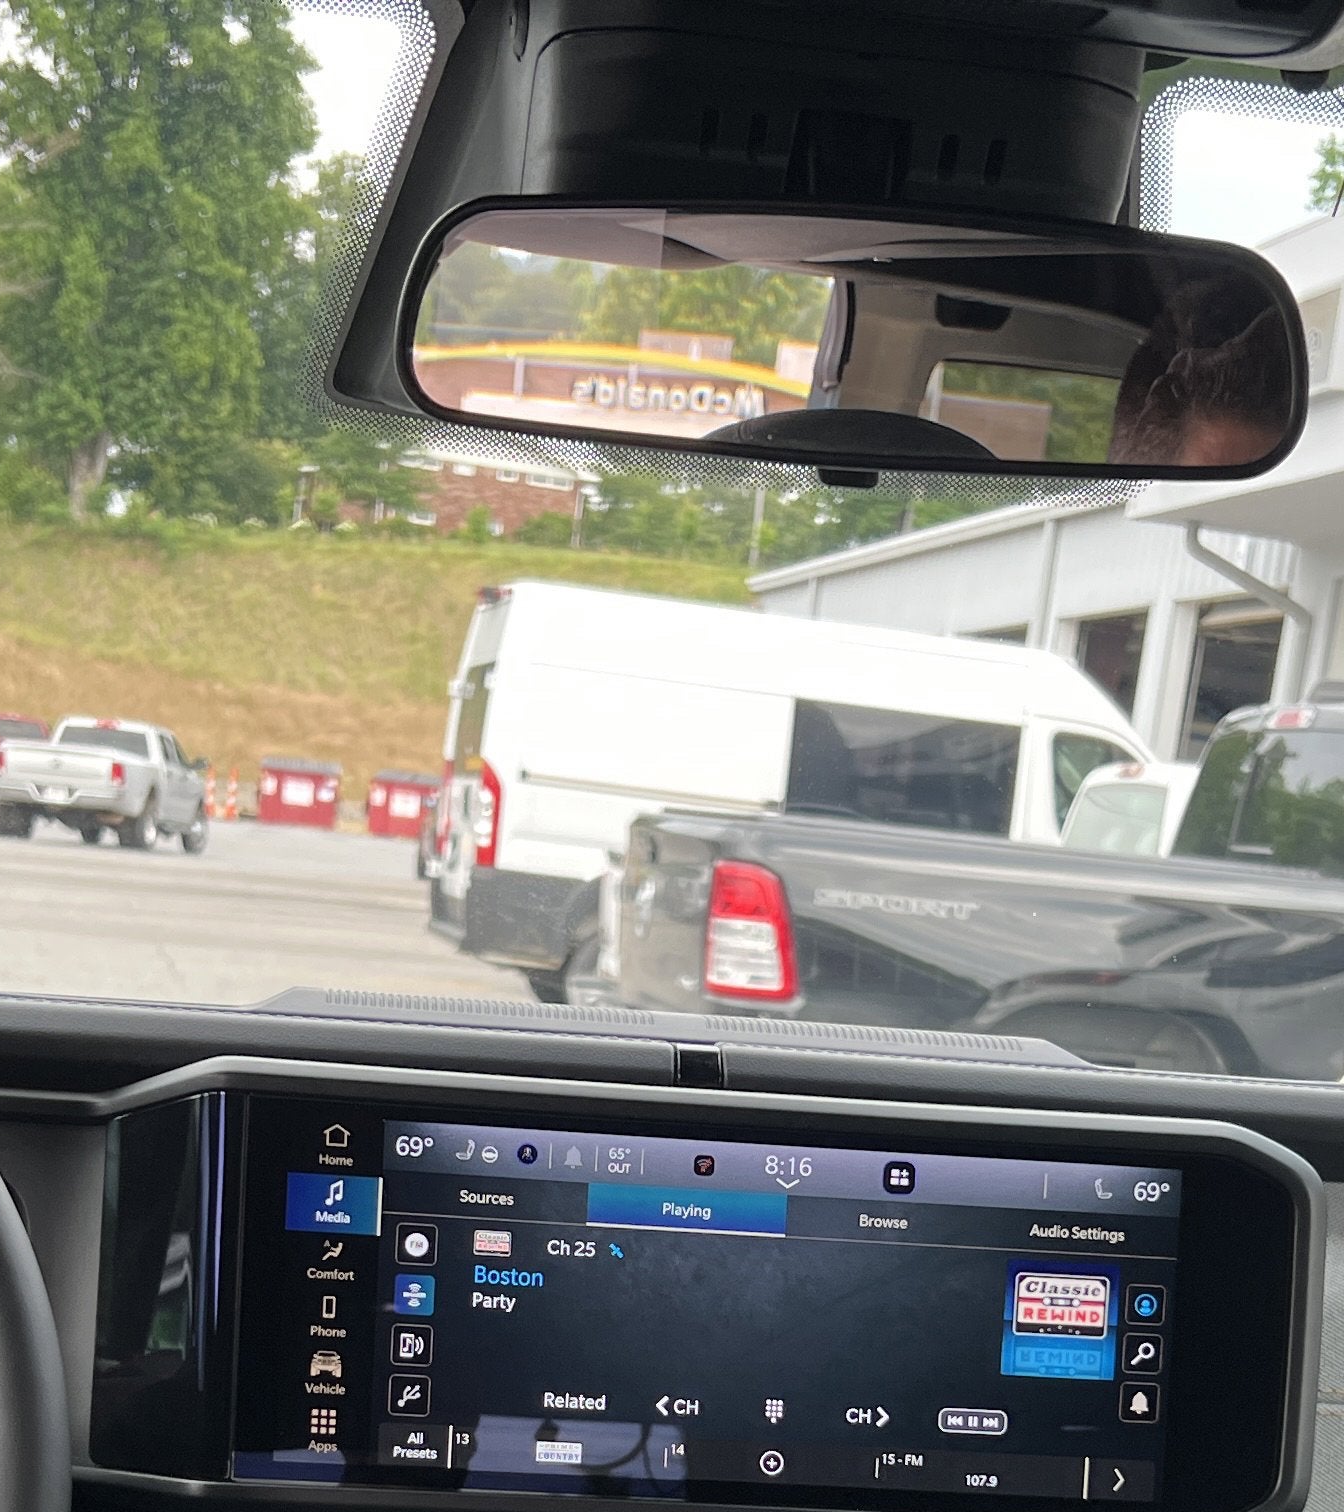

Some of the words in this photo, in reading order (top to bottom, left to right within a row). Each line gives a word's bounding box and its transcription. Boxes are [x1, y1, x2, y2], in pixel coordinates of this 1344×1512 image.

[395, 1135, 434, 1158] 69°
[318, 1153, 354, 1167] Home
[607, 1162, 632, 1175] OUT
[763, 1154, 813, 1178] 8:16
[459, 1189, 515, 1206] Sources
[1132, 1181, 1171, 1203] 69°
[315, 1210, 351, 1224] Media
[662, 1202, 712, 1221] Playing
[859, 1213, 909, 1230] Browse
[1029, 1223, 1071, 1240] Audio
[1071, 1226, 1126, 1244] Settings
[547, 1239, 571, 1256] Ch
[573, 1240, 597, 1257] 25
[306, 1267, 355, 1281] Comfort
[473, 1264, 544, 1288] Boston
[1024, 1280, 1102, 1297] Classic
[471, 1291, 517, 1313] Party
[1022, 1306, 1101, 1324] REWIND
[309, 1325, 347, 1338] Phone
[304, 1382, 346, 1396] Vehicle
[542, 1390, 607, 1411] Related
[672, 1398, 700, 1416] CH
[845, 1407, 873, 1425] CH
[307, 1439, 338, 1454] Apps
[407, 1431, 425, 1445] All
[455, 1432, 471, 1446] 13
[392, 1445, 438, 1460] Presets
[537, 1452, 581, 1463] COUNTRY
[670, 1443, 686, 1456] 14
[904, 1454, 924, 1467] FM
[964, 1474, 999, 1488] 107.9
